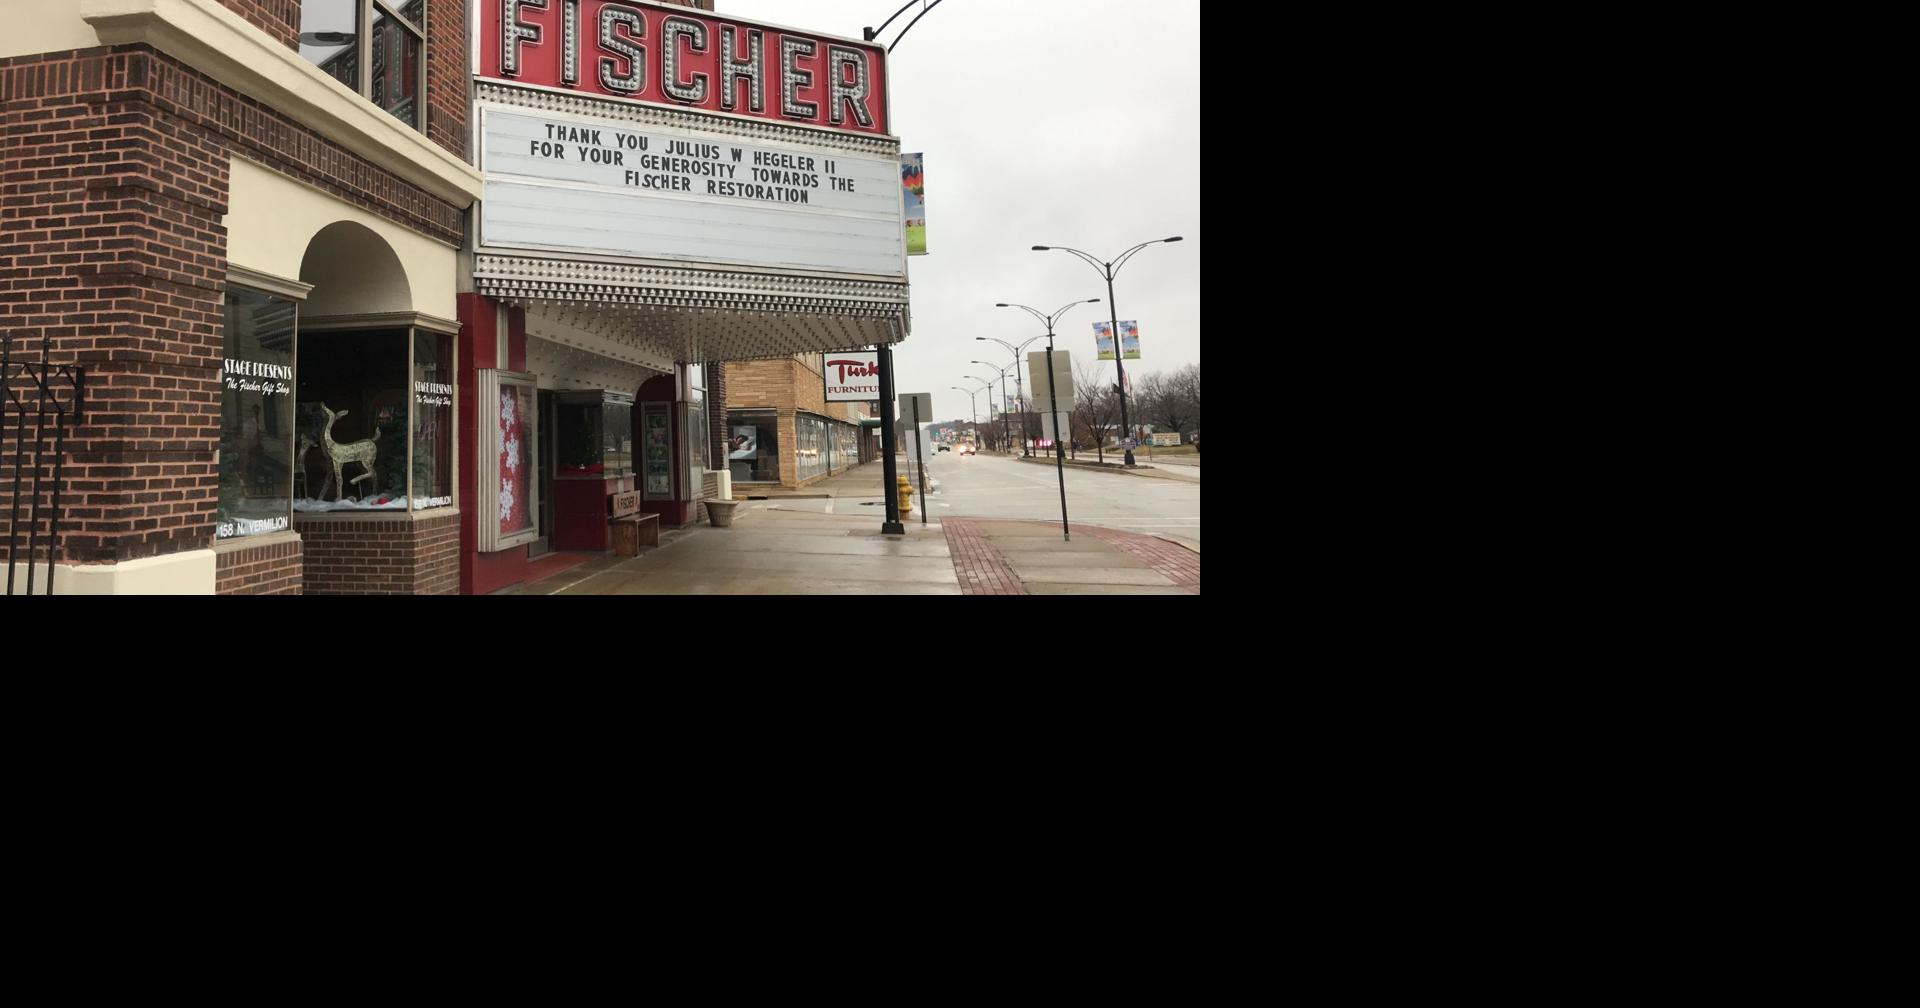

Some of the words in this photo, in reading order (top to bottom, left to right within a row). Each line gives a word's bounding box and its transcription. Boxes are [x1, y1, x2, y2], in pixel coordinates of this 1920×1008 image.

[500, 0, 876, 128] FISCHER
[545, 123, 601, 146] THANK
[615, 132, 649, 151] YOU
[665, 140, 720, 160] JULIUS
[730, 147, 742, 162] W
[753, 151, 815, 172] HEGELER
[824, 159, 835, 174] II
[530, 140, 565, 160] FOR
[578, 146, 624, 167] YOUR
[640, 154, 736, 179] GENEROSITY
[751, 167, 819, 188] TOWARDS
[829, 176, 855, 193] THE
[625, 170, 691, 192] FISCHER
[707, 179, 808, 204] RESTORATION
[224, 358, 252, 376] STAGE
[252, 362, 292, 380] PRESENTS
[226, 377, 238, 390] The
[239, 379, 261, 392] Fischer
[262, 381, 275, 396] Gift
[275, 382, 290, 397] Shop
[827, 385, 880, 394] FURNITU
[219, 523, 234, 538] 158
[248, 516, 289, 533] VERMILION
